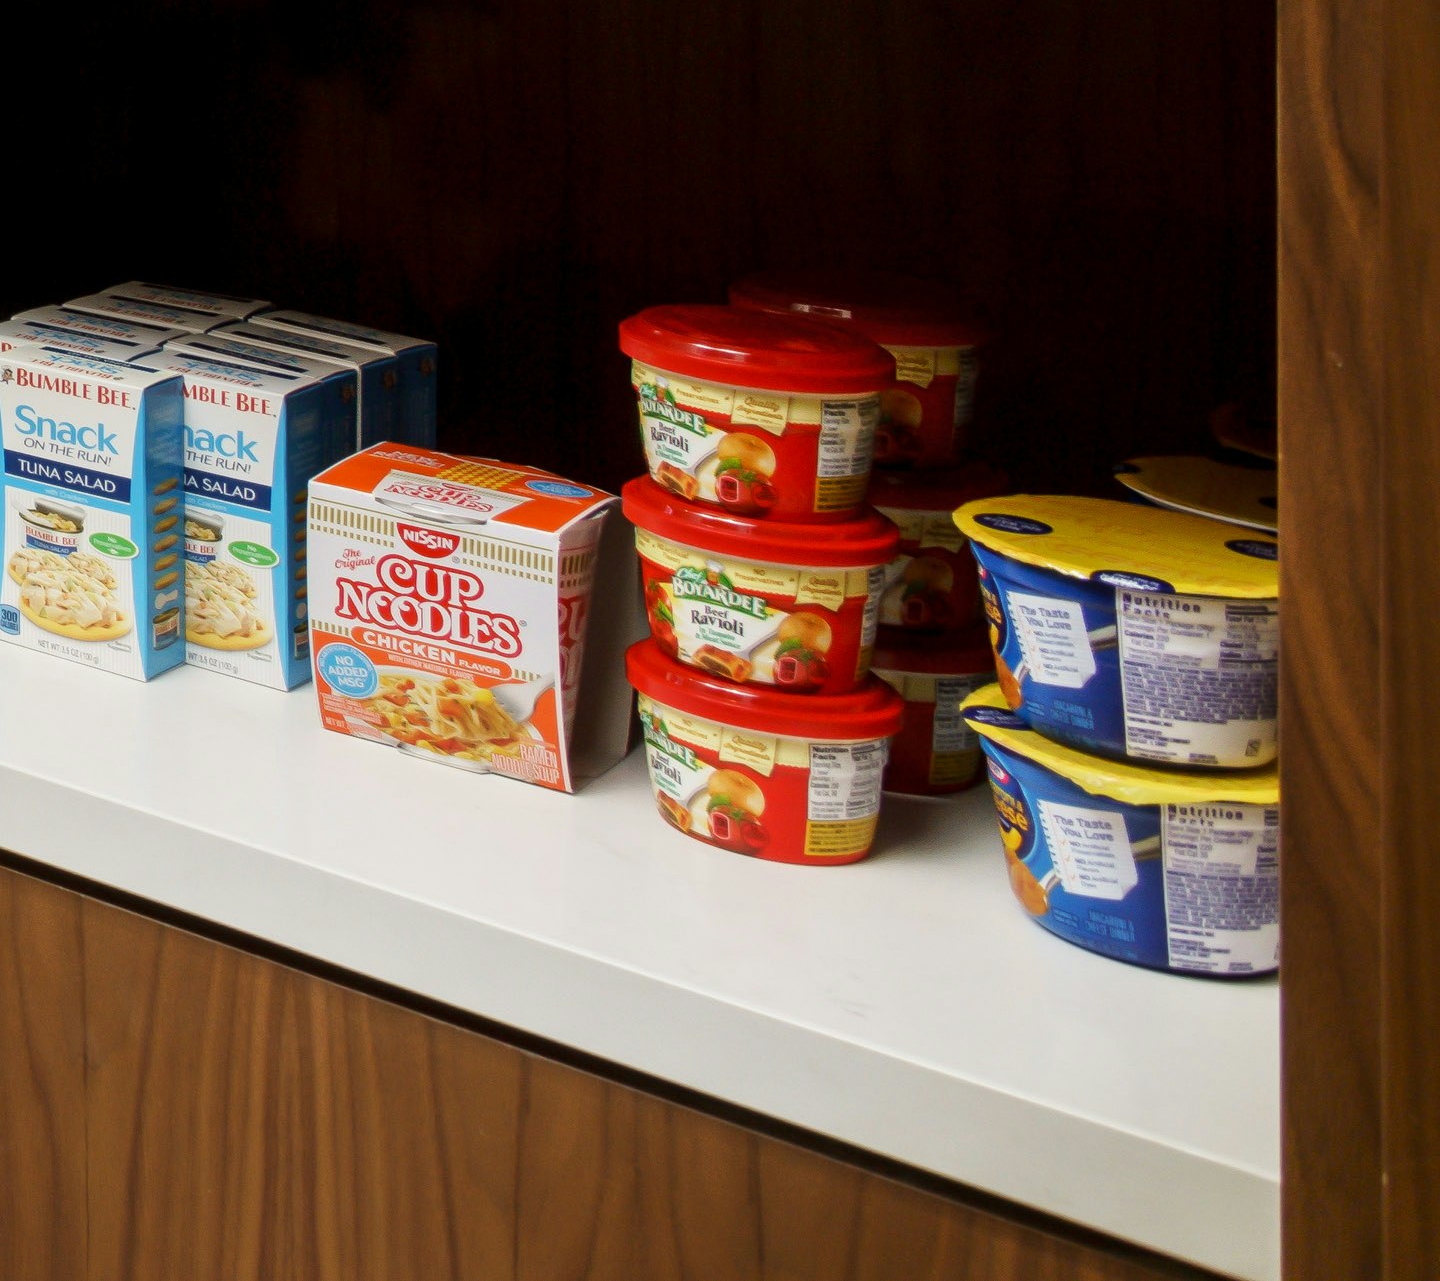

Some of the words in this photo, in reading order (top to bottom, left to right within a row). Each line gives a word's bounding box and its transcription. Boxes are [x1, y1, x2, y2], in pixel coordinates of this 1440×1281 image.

[17, 367, 89, 401] BUMBLE
[14, 403, 119, 456] Snack
[651, 426, 689, 453] Ravioli
[24, 438, 47, 451] ON
[50, 442, 77, 459] THE
[79, 448, 112, 467] RUN!
[18, 458, 61, 481] TUNA
[64, 470, 116, 494] SALAD
[202, 479, 256, 501] SALAD
[343, 549, 361, 558] The
[403, 530, 453, 550] NISSIN
[334, 556, 376, 569] Original
[377, 554, 484, 607] CUP
[1122, 593, 1201, 613] Nutrition
[336, 578, 522, 658] NOODLES
[691, 610, 744, 637] Ravioli
[335, 656, 353, 666] NO
[363, 632, 456, 665] CHICKEN
[458, 660, 501, 676] FLAVOR
[329, 665, 367, 678] ADDED
[338, 677, 364, 689] MSG
